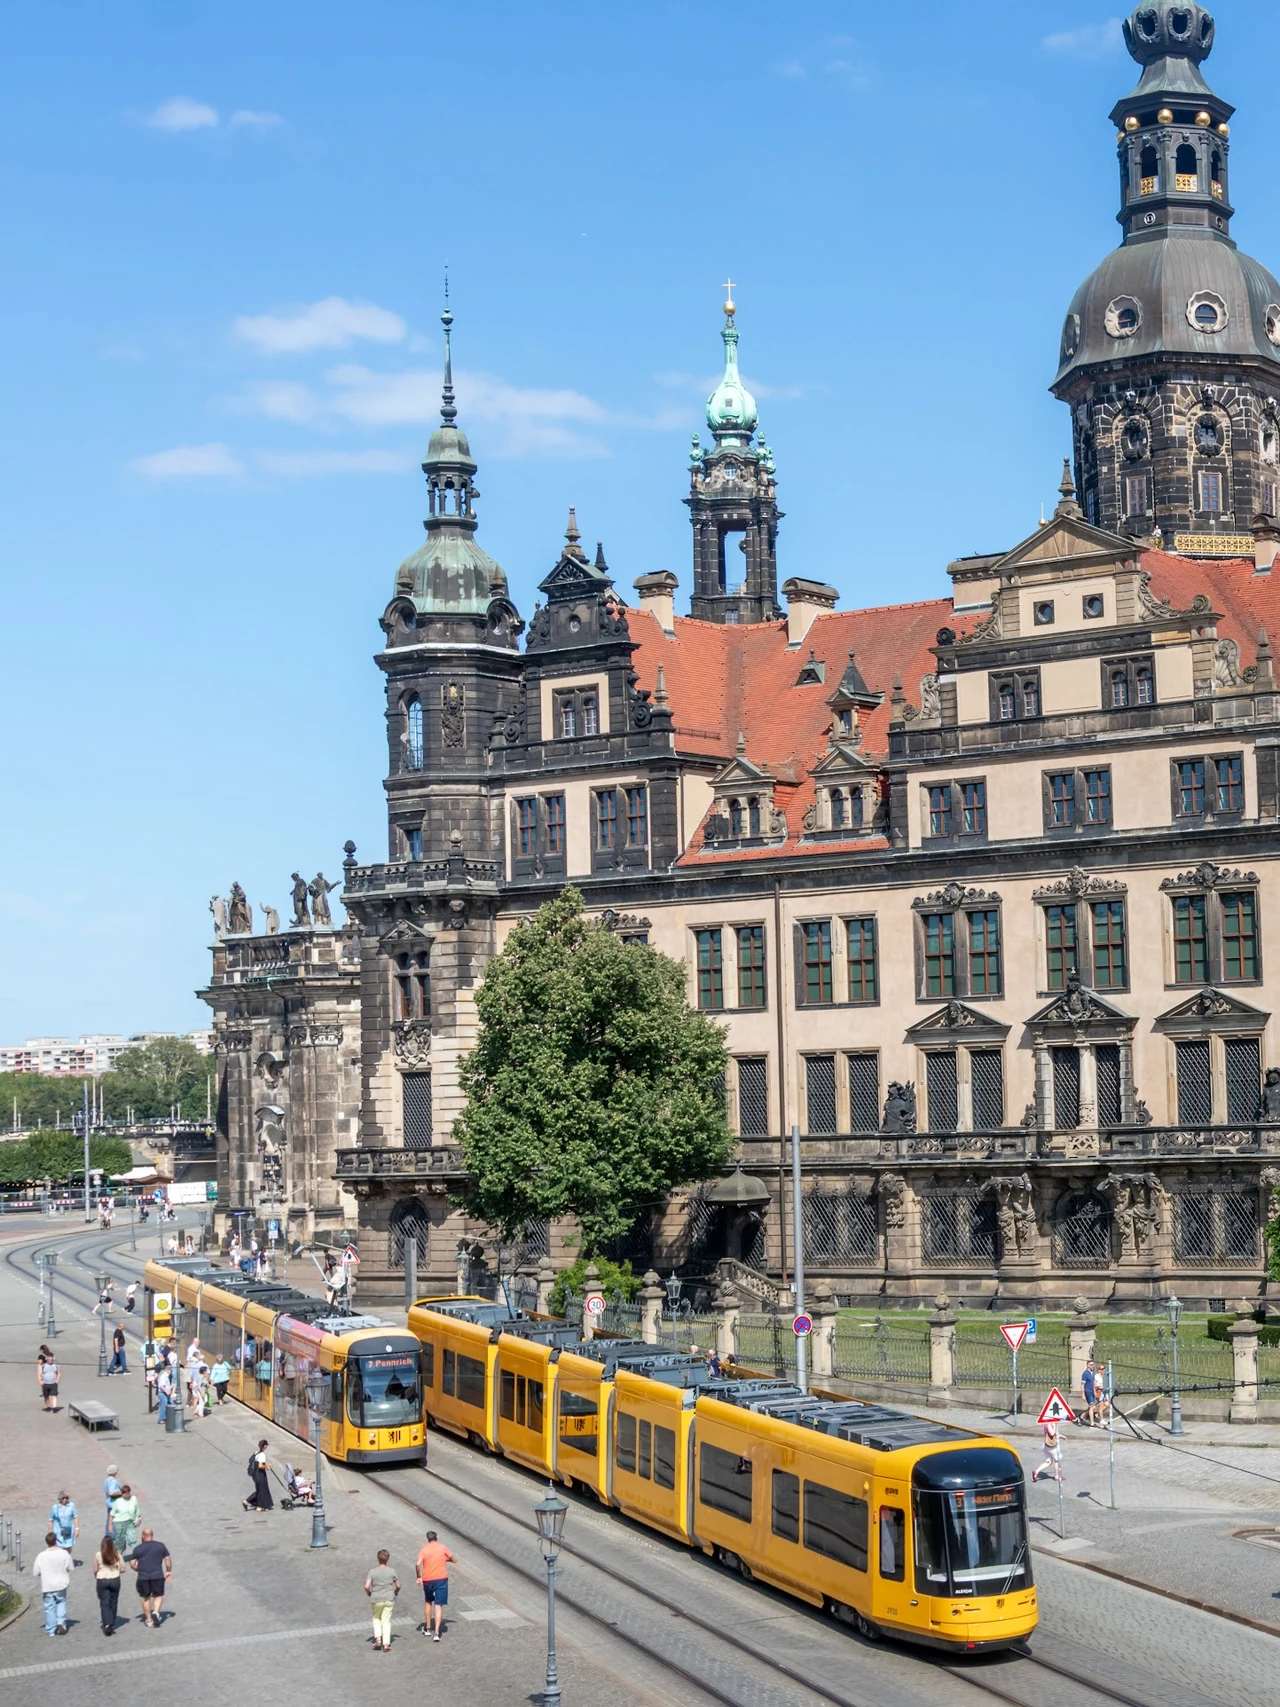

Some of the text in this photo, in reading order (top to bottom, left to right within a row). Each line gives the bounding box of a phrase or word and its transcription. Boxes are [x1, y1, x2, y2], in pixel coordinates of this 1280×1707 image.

[590, 1300, 602, 1310] 30
[368, 1357, 412, 1368] 7 Pennrich
[956, 1497, 962, 1508] 3
[993, 1493, 1012, 1502] Mann
